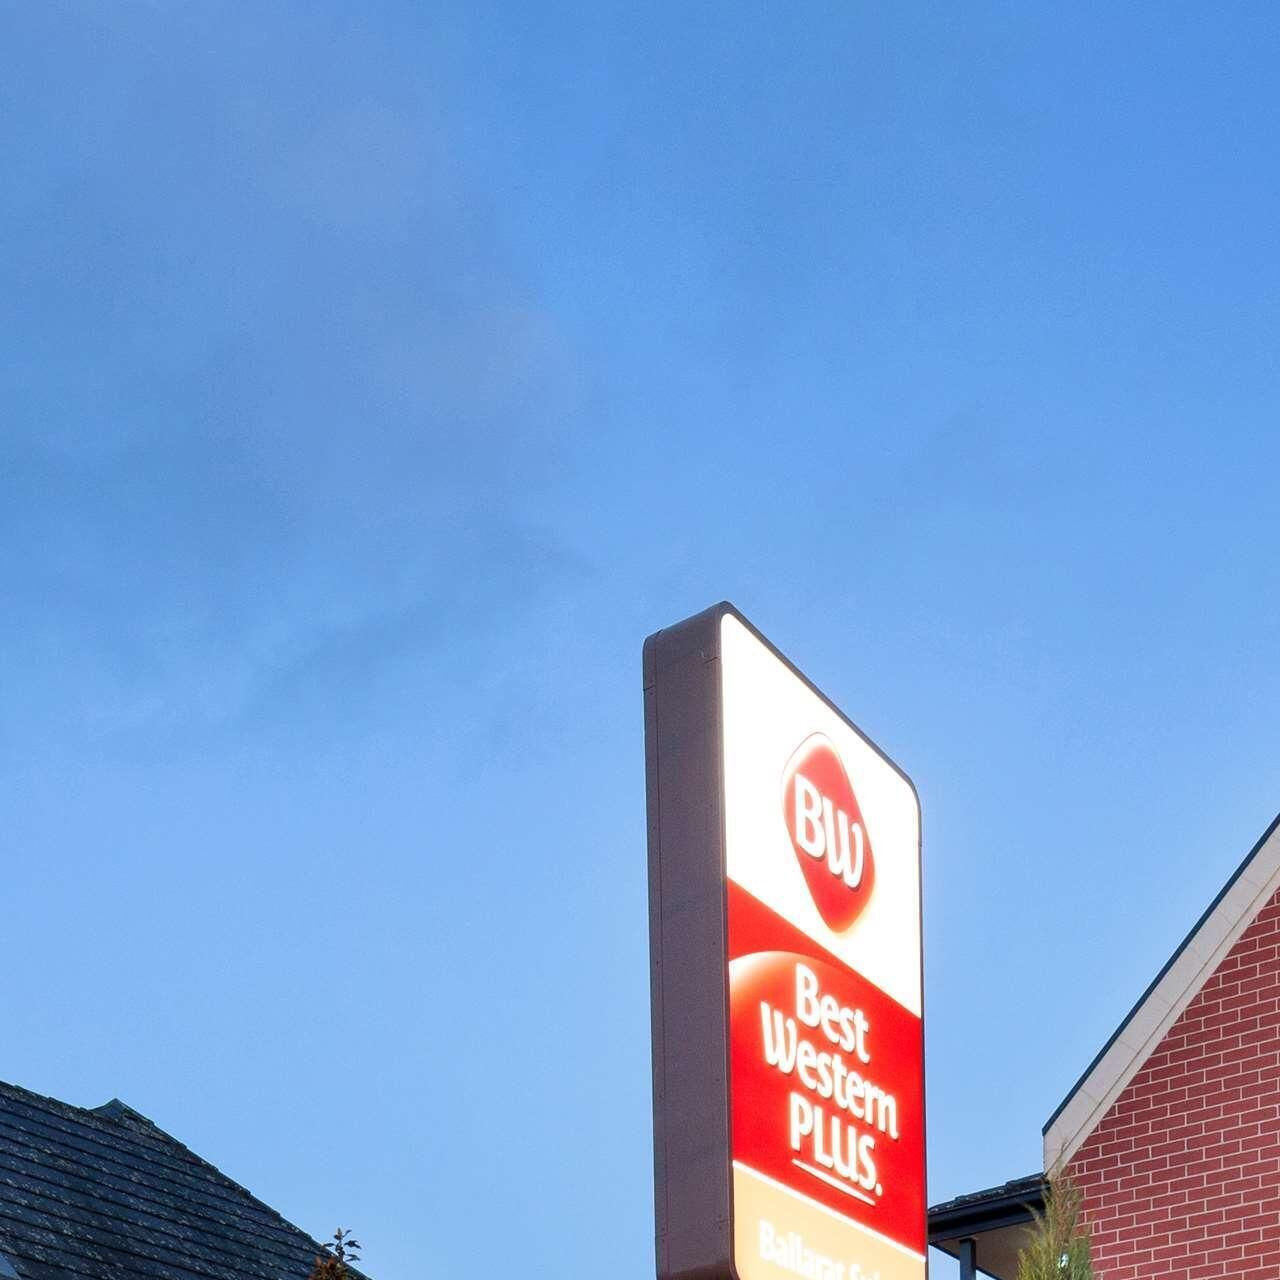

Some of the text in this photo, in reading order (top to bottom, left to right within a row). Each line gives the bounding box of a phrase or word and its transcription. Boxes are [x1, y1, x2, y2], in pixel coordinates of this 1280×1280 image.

[795, 773, 864, 888] BW
[760, 1001, 899, 1139] Western
[795, 963, 870, 1063] Best
